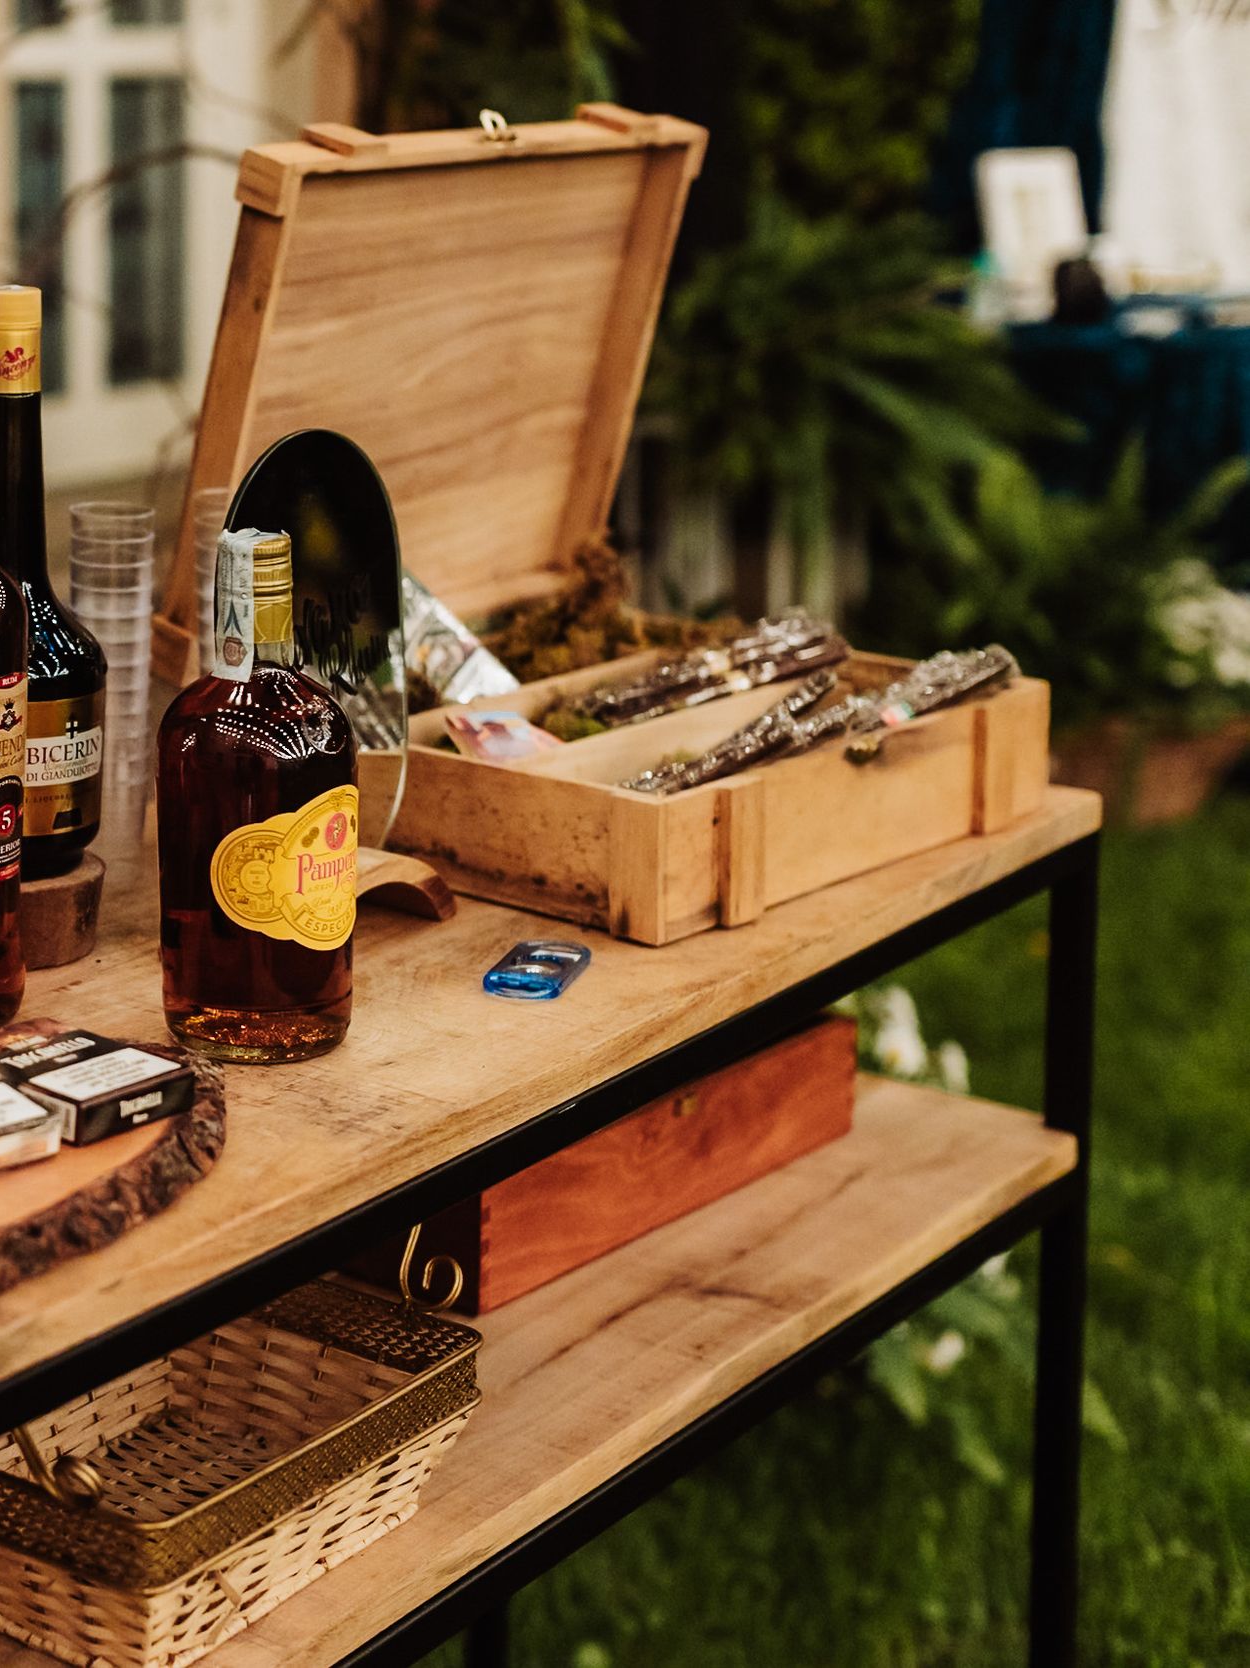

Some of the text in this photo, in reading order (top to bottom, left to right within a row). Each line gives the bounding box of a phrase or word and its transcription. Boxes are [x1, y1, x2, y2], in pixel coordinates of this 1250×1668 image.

[2, 675, 18, 686] RUM
[26, 736, 100, 766] BICERIN
[26, 772, 38, 782] DI
[1, 809, 11, 830] 5
[295, 851, 357, 896] Pamper
